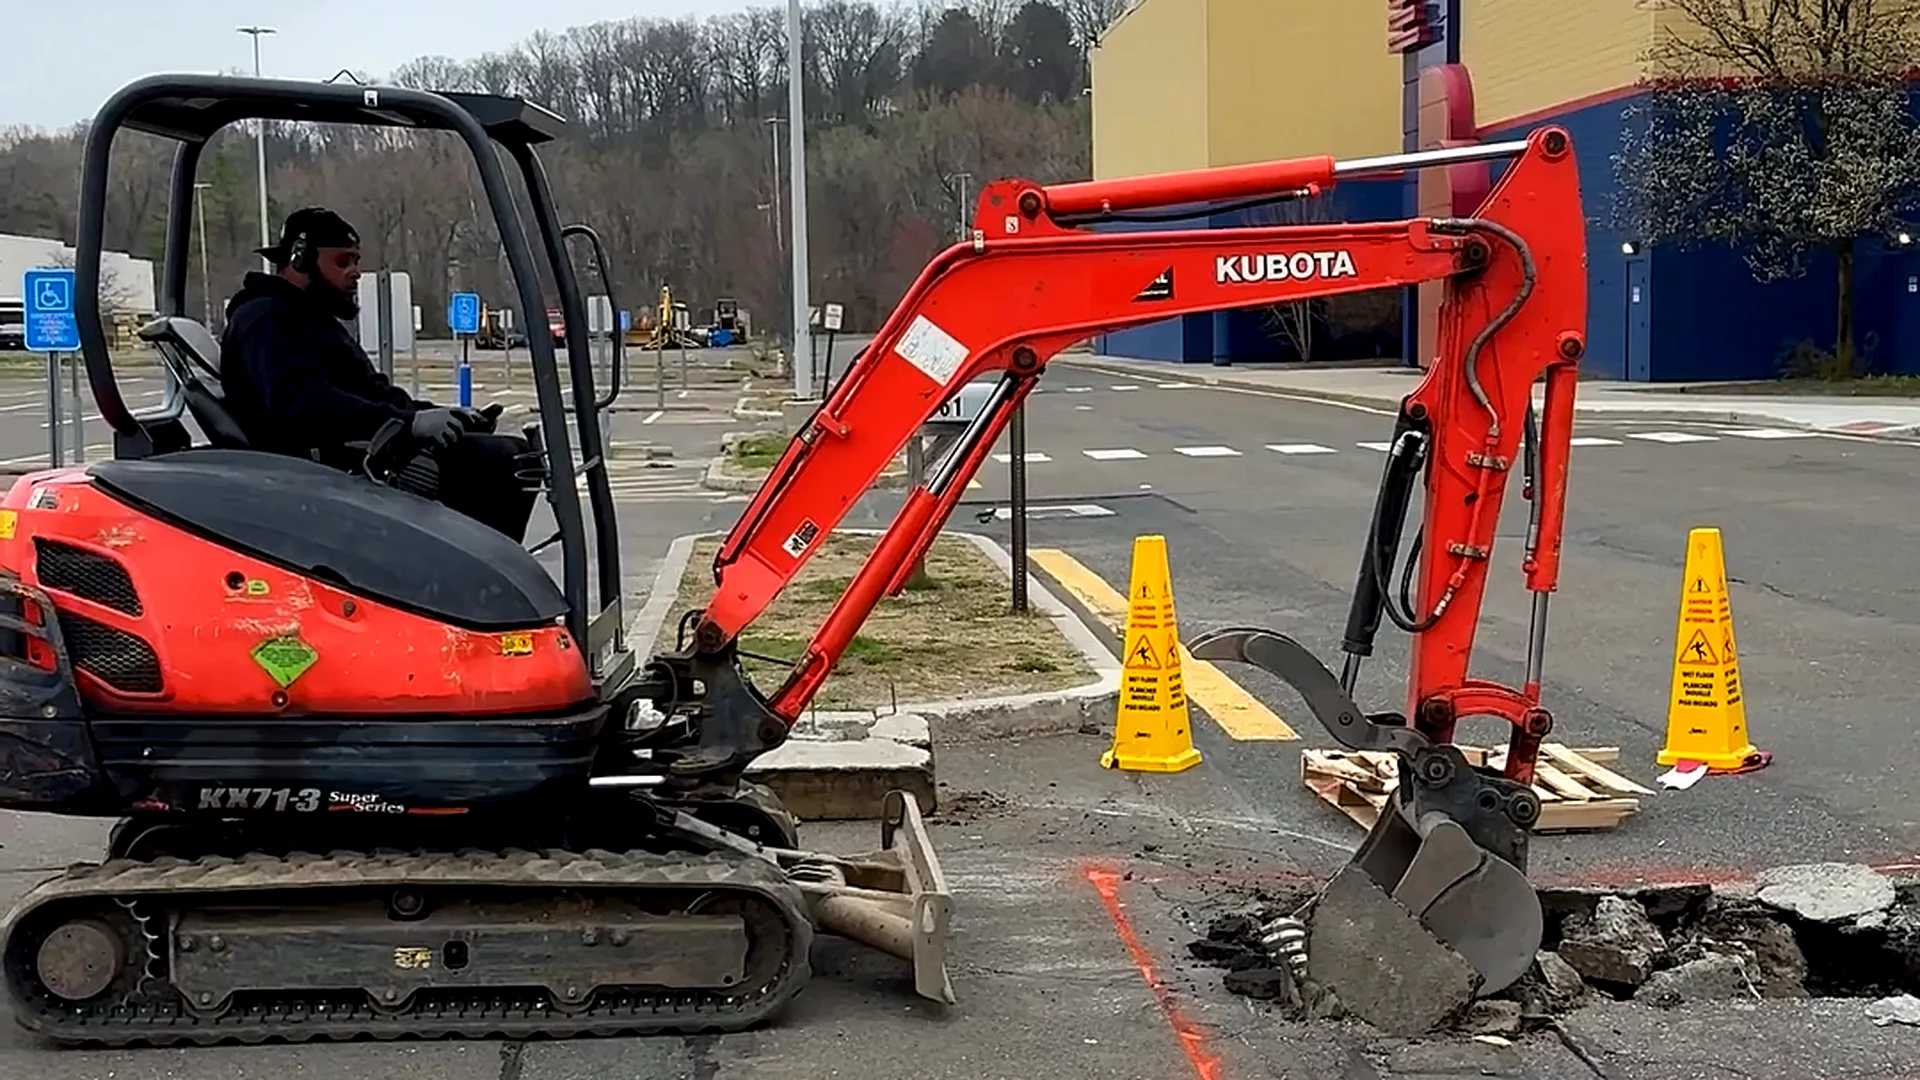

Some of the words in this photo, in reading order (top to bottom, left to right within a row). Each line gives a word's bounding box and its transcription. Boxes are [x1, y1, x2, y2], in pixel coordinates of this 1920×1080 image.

[1216, 250, 1357, 282] KUBOTA
[198, 788, 321, 812] KX71-3
[329, 791, 380, 804] Super
[353, 801, 405, 814] Series
